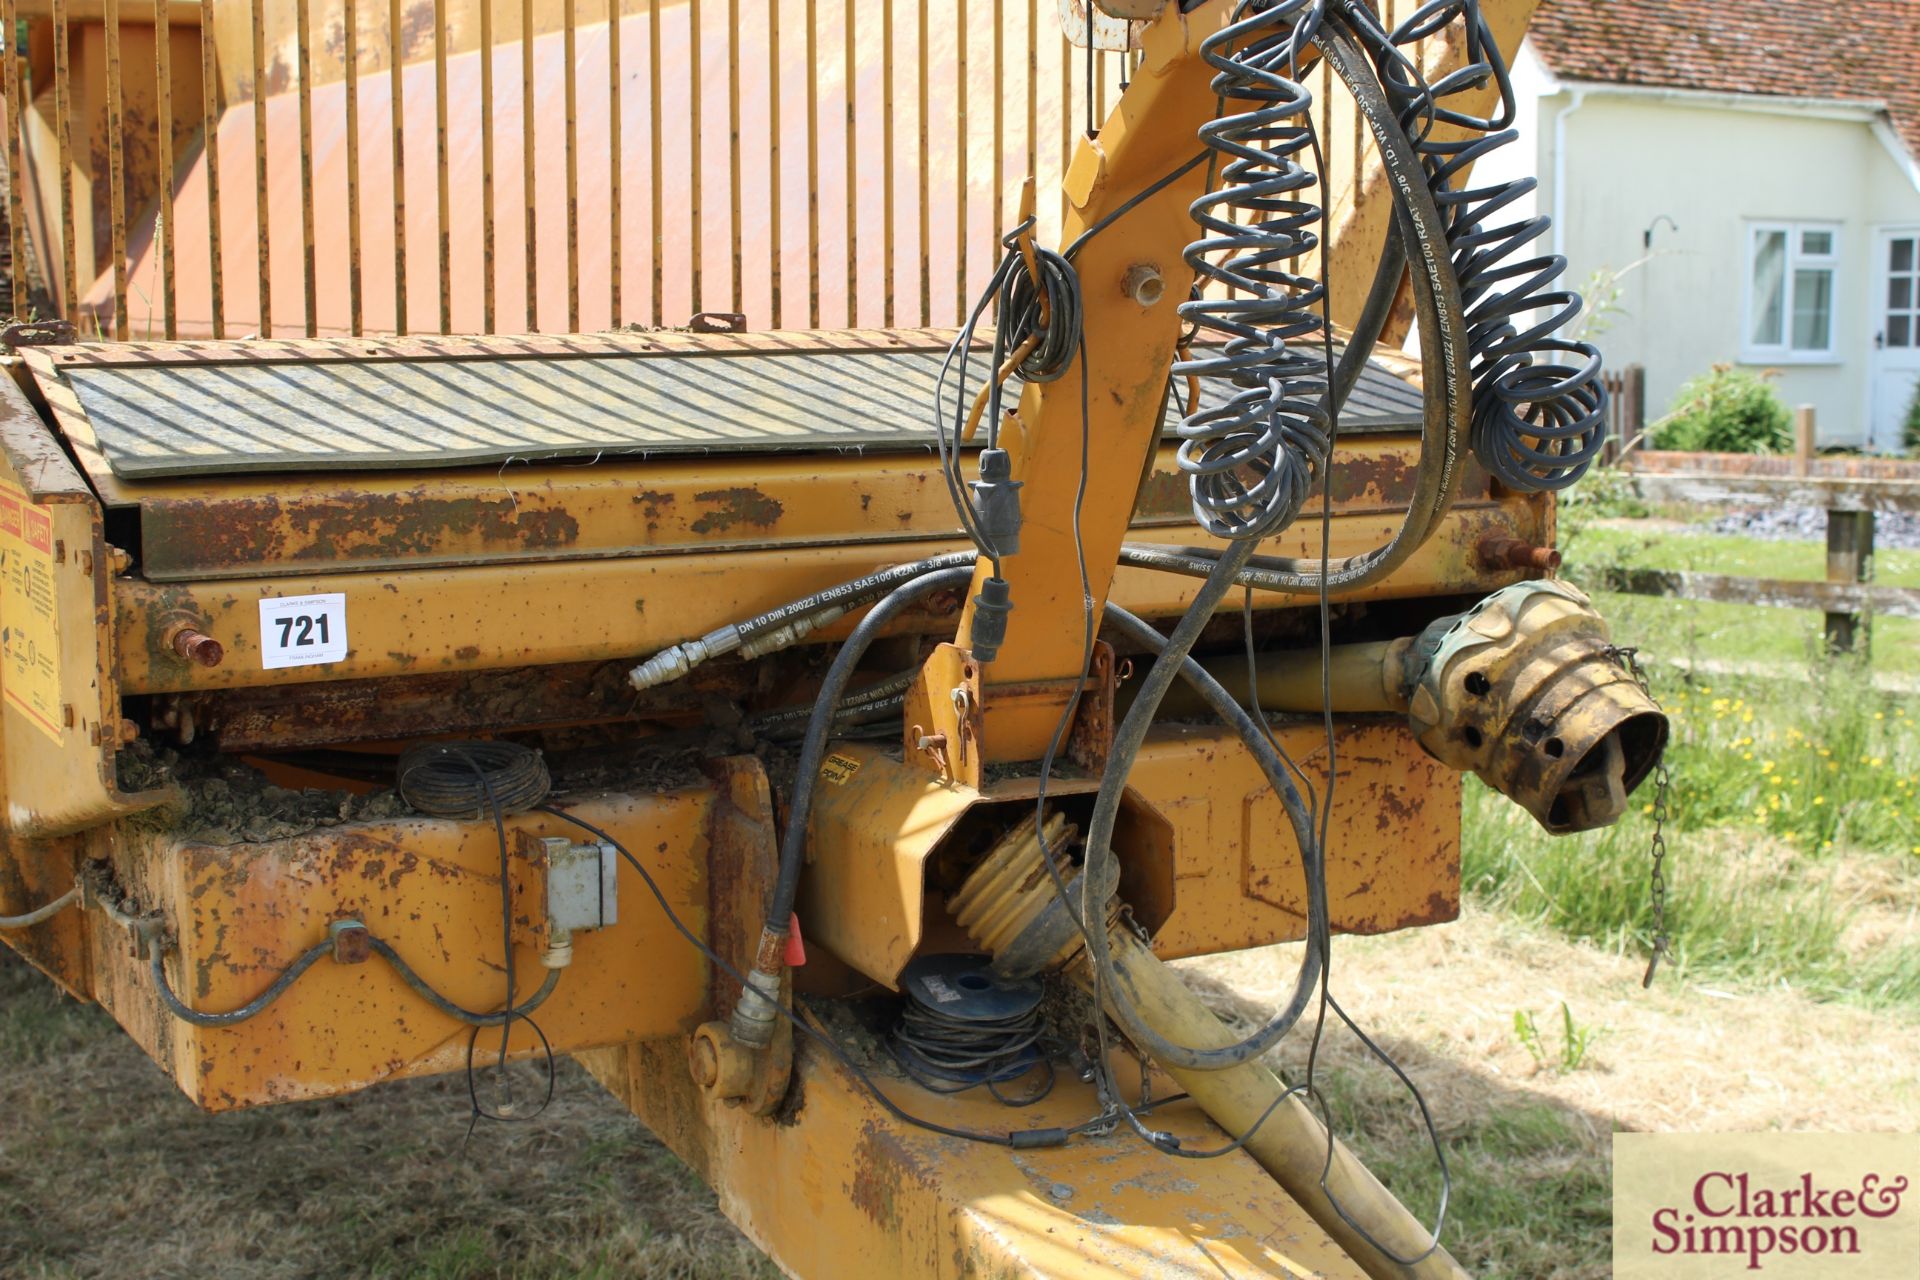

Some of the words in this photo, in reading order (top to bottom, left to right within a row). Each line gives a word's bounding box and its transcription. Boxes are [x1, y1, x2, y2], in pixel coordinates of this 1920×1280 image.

[1344, 74, 1360, 94] Bar
[1357, 95, 1374, 115] 330
[1371, 116, 1388, 144] W.P.
[1408, 207, 1428, 239] R2AT
[1422, 243, 1442, 291] SAE100
[1435, 296, 1451, 333] EN853
[1443, 342, 1456, 375] 20022
[1447, 377, 1457, 397] DIN
[1188, 561, 1212, 573] swiss
[1268, 573, 1279, 584] DN
[1280, 575, 1288, 585] 10
[1300, 576, 1317, 587] 20022
[738, 622, 754, 634] DN
[755, 616, 767, 627] 10
[768, 608, 786, 622] DIN
[787, 597, 816, 615] 20022
[821, 584, 853, 602] EN853
[853, 574, 892, 591] SAE100
[894, 565, 919, 580] R2AT
[927, 557, 946, 569] 3/8"
[275, 613, 329, 648] 721
[868, 687, 885, 699] DIN
[874, 698, 889, 709] 330
[828, 755, 858, 772] GREASE
[822, 768, 846, 781] POINT
